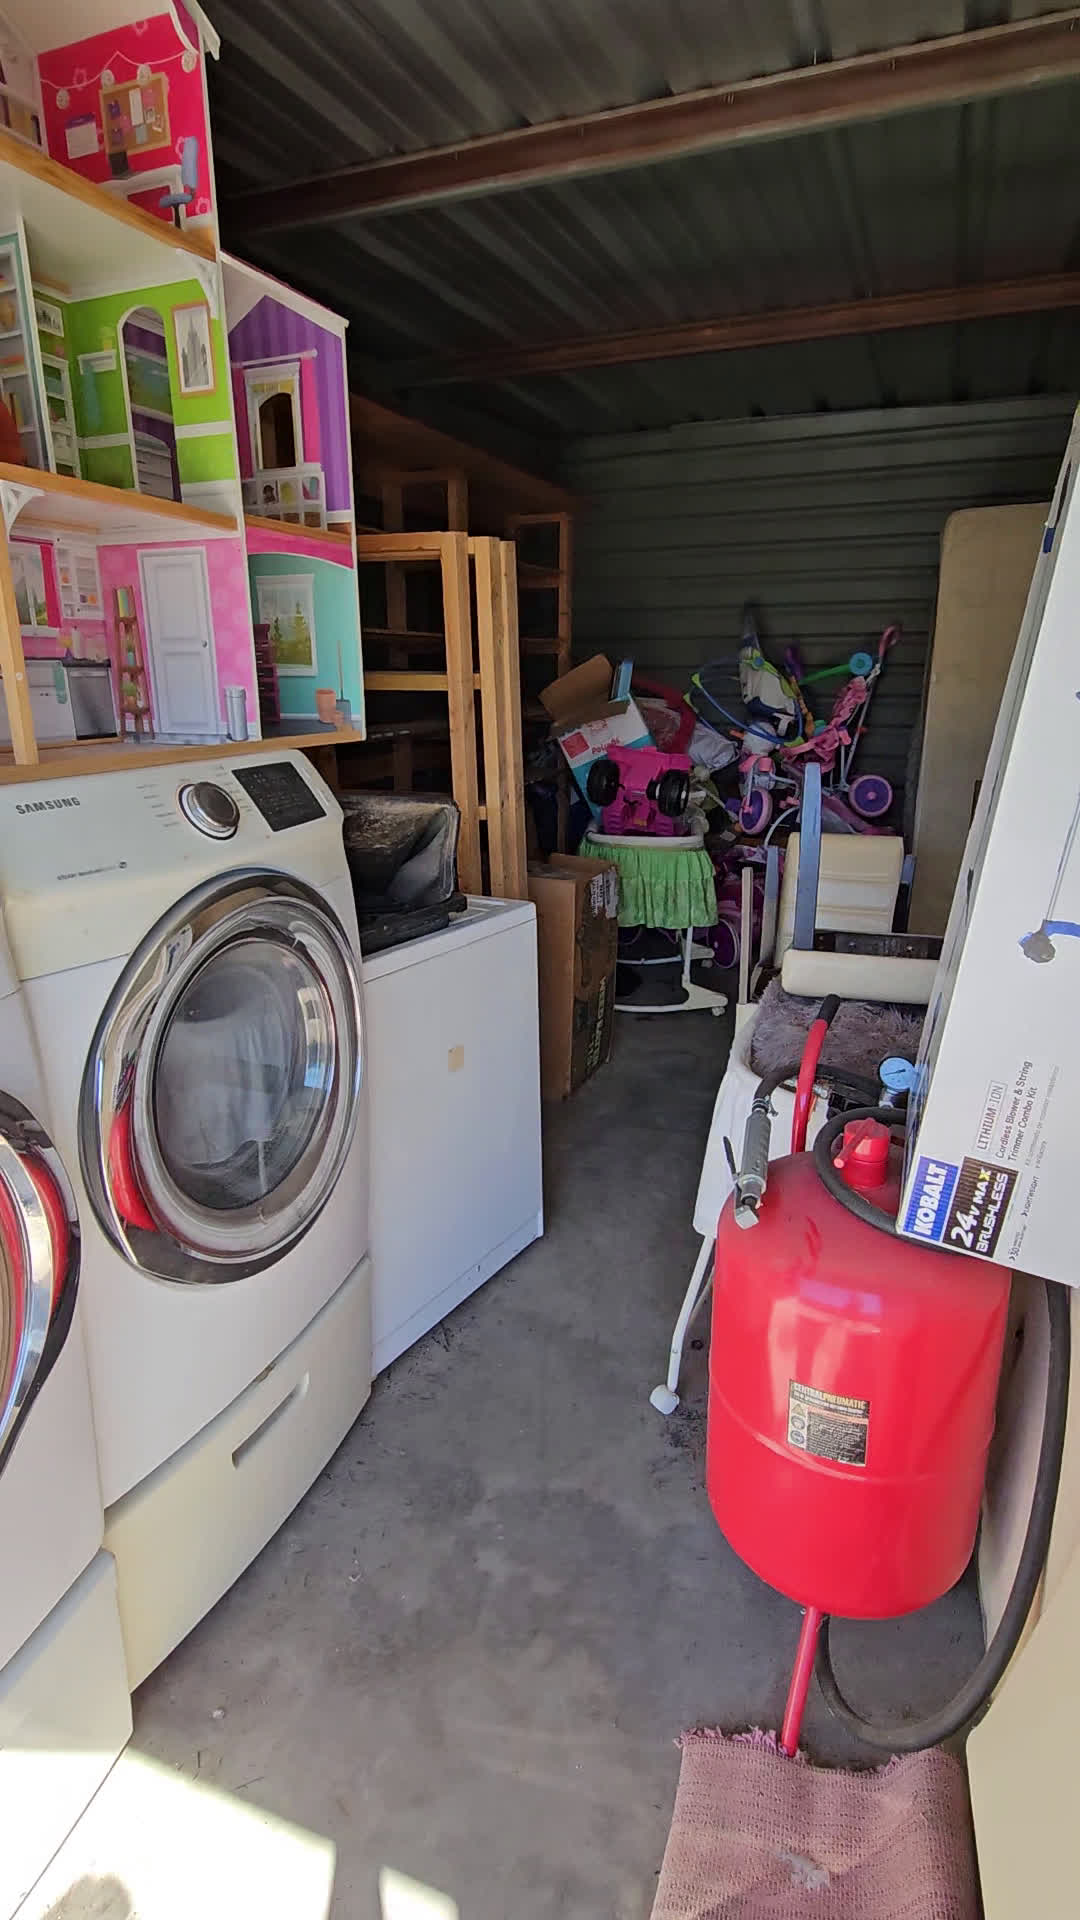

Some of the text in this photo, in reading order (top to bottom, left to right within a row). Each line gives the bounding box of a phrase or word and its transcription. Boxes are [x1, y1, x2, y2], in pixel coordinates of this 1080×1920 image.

[16, 797, 81, 815] SAMSUNG
[995, 1061, 1033, 1159] Cordless Blower & String
[1008, 1130, 1025, 1161] Trimmer
[1018, 1100, 1034, 1129] Combo
[1027, 1087, 1038, 1099] Kit
[914, 1163, 947, 1236] KOBALT
[973, 1168, 992, 1205] MAX
[976, 1172, 1008, 1252] BRUSHLESS
